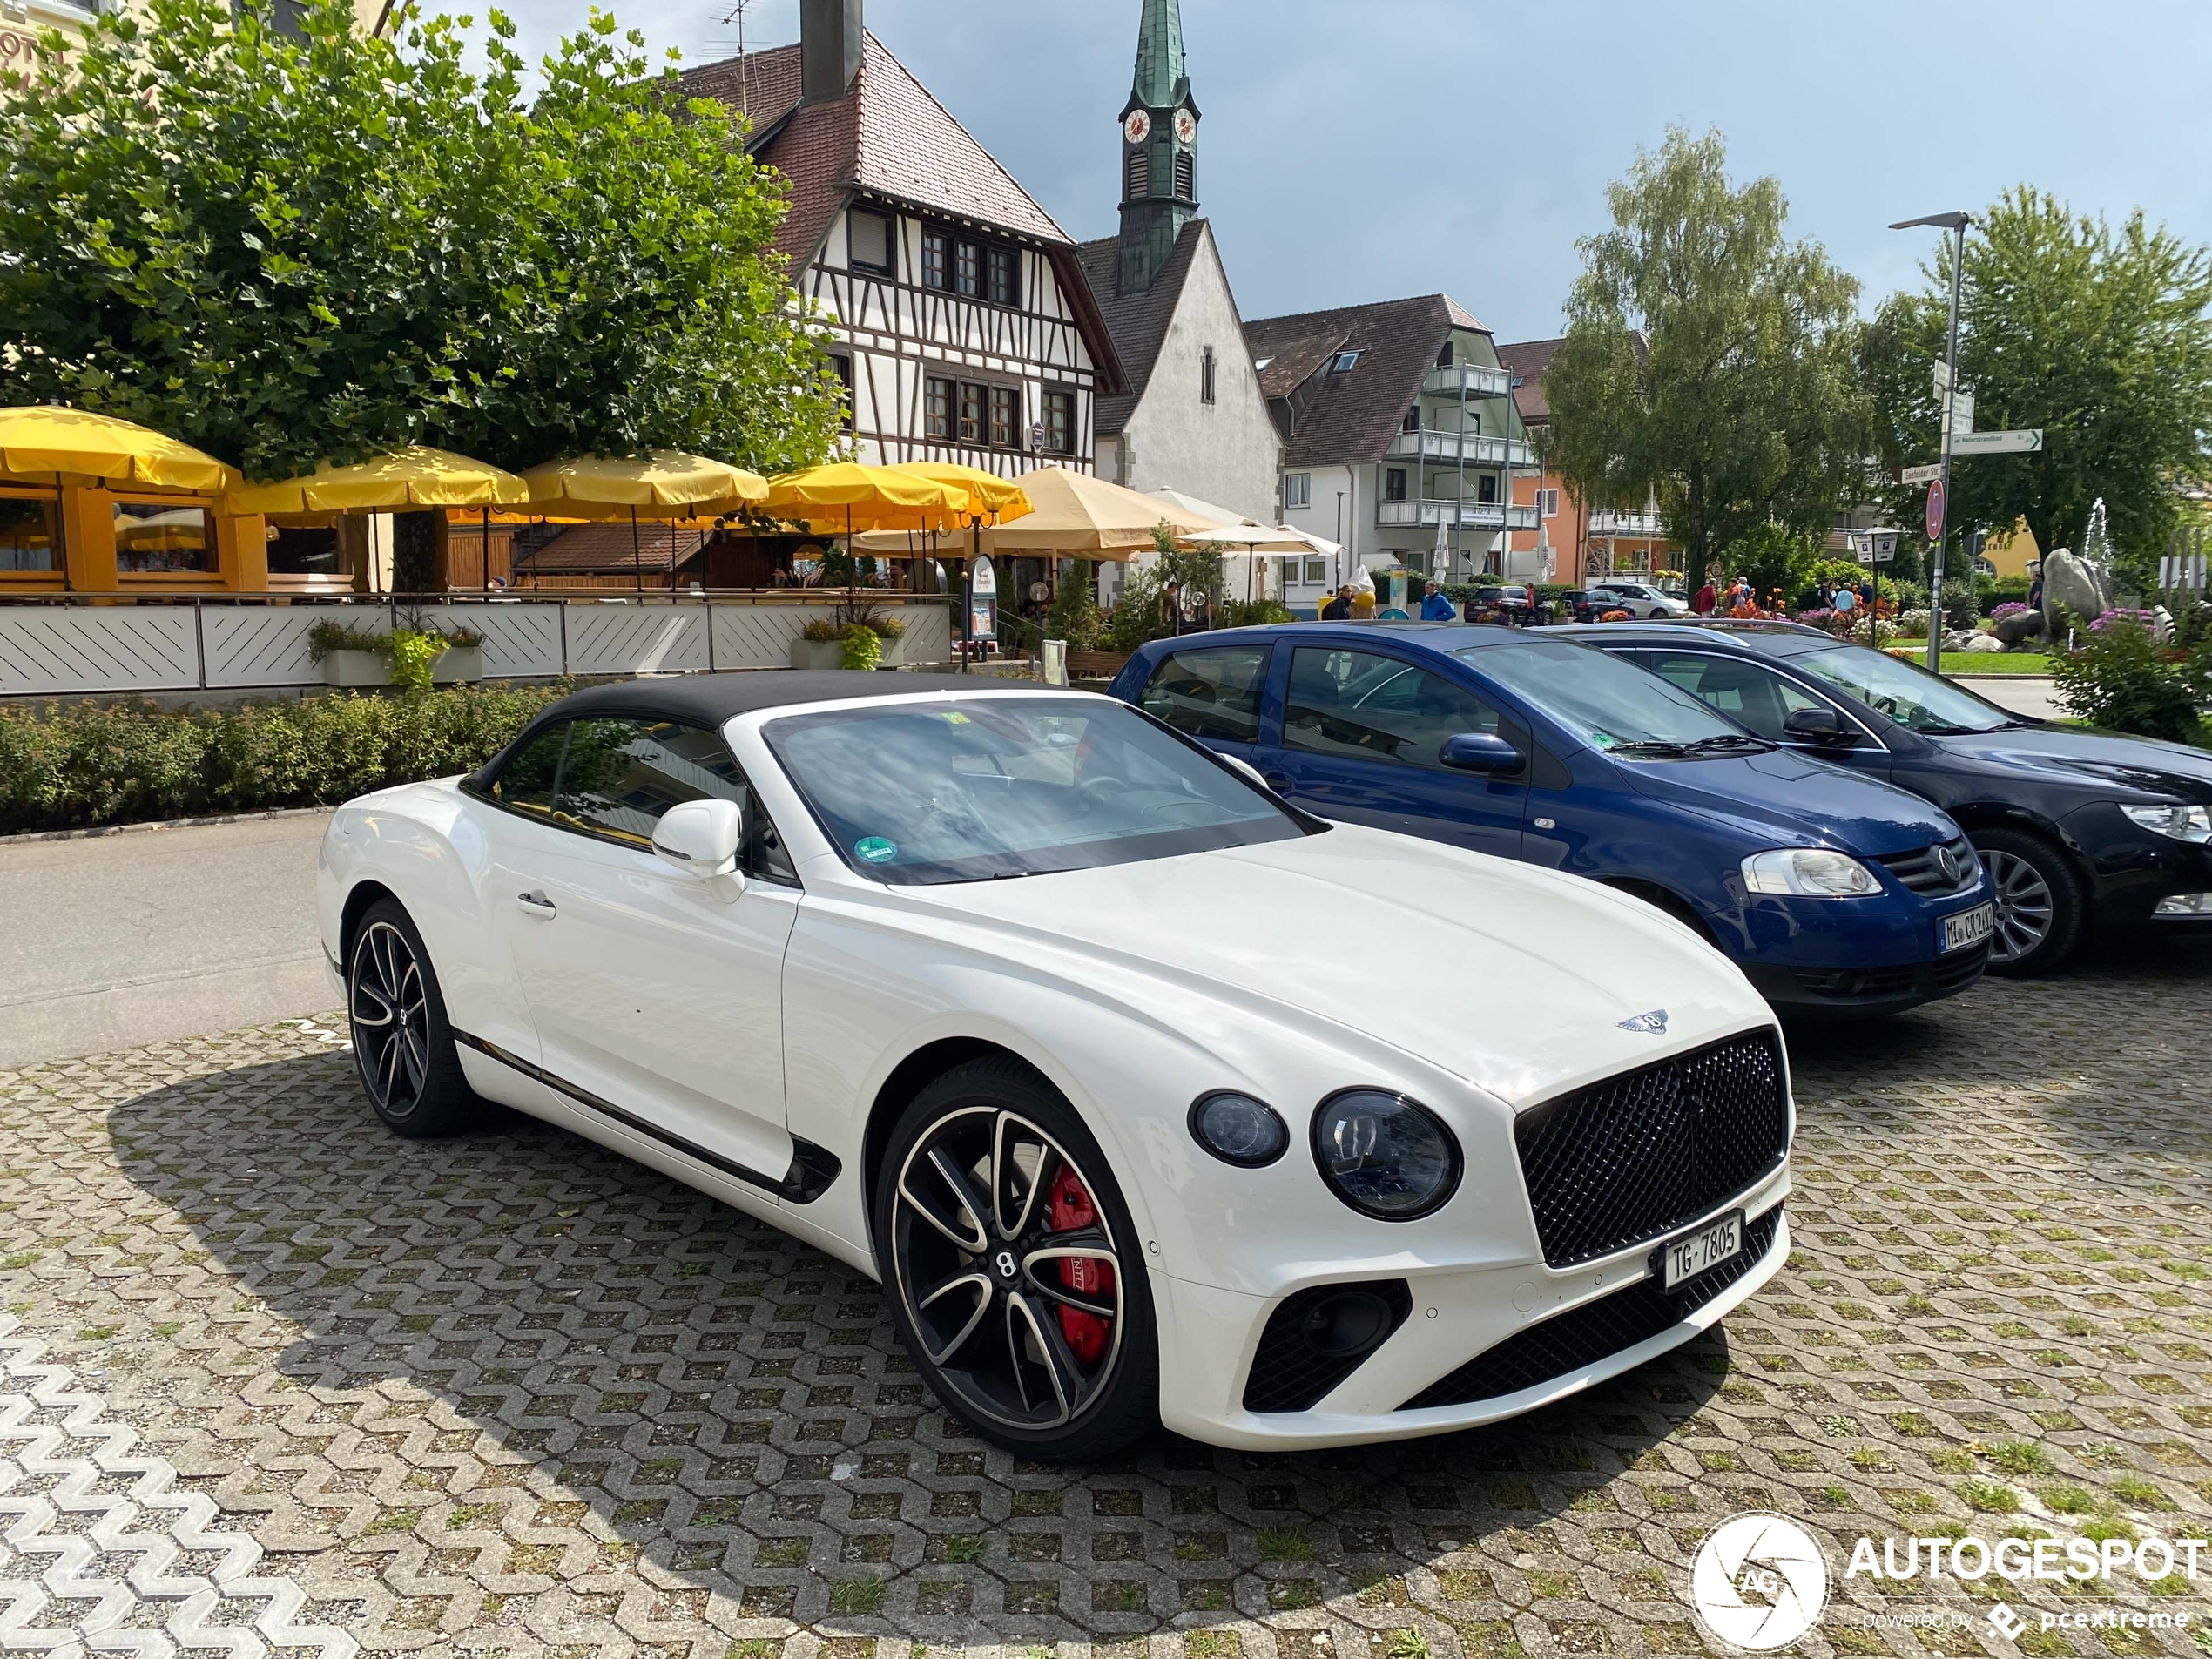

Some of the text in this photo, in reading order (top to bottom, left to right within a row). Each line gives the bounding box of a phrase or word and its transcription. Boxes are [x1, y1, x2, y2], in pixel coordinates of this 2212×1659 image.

[1905, 467, 1939, 480] Seefelder Str.
[1946, 920, 1959, 946] MI
[1673, 1221, 1735, 1279] TG 7805
